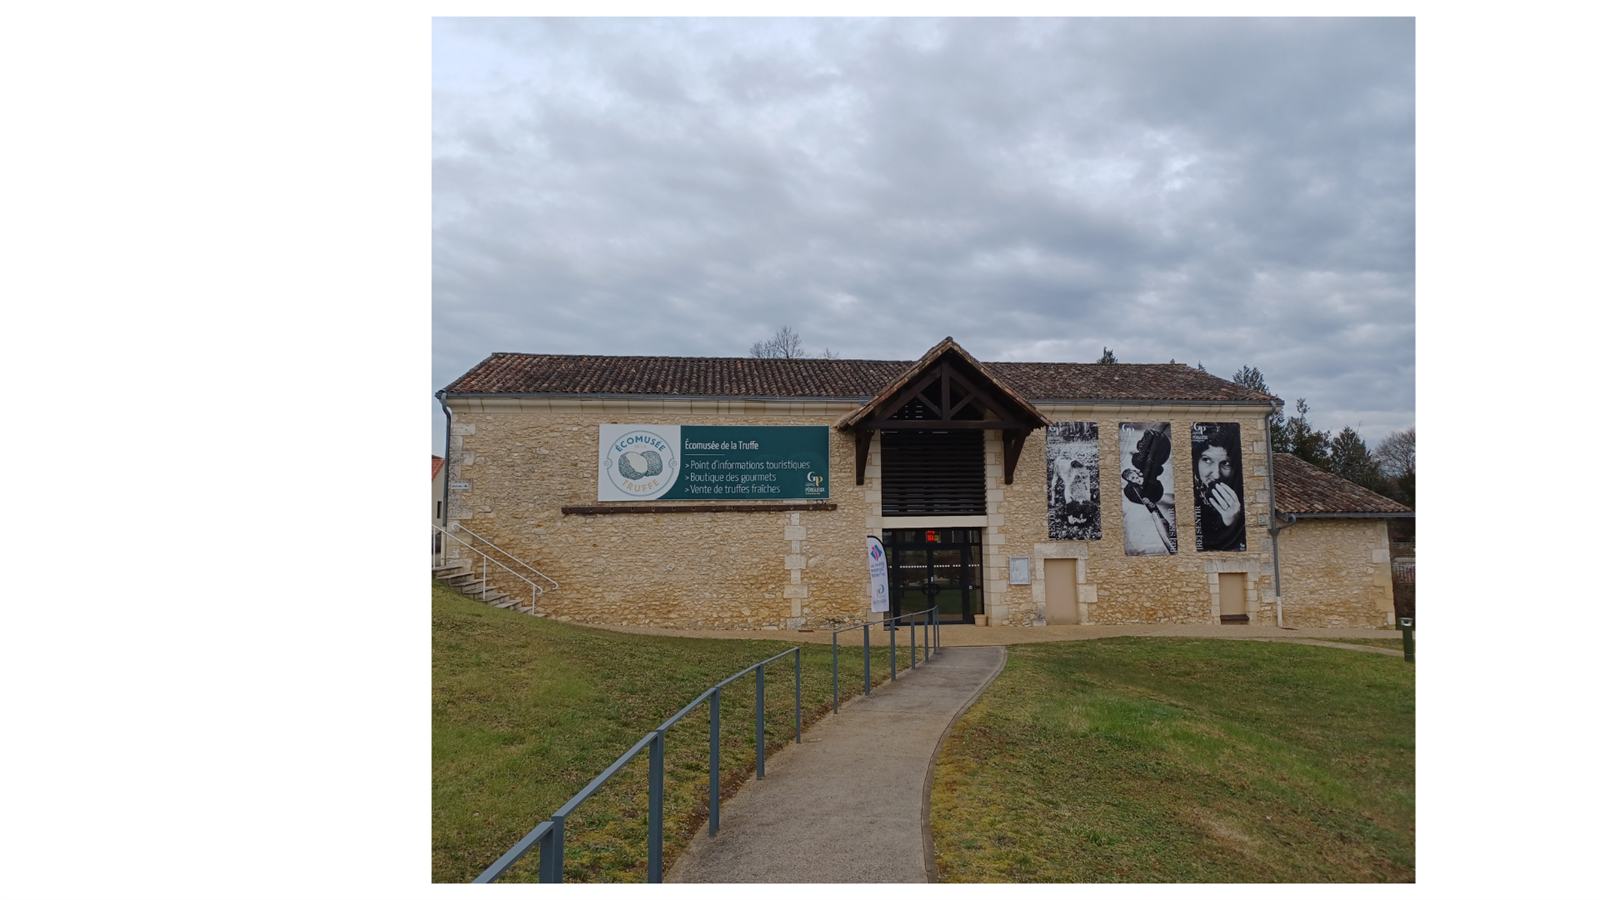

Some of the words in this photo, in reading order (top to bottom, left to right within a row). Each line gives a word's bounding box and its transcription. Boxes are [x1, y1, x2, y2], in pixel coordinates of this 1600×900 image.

[615, 435, 666, 453] ÉCOMUSÉE
[684, 438, 719, 450] Écomusée
[721, 440, 730, 450] de
[731, 440, 738, 450] la
[738, 440, 759, 450] Truffe
[690, 460, 710, 470] Point
[711, 460, 764, 470] d'informations
[766, 460, 811, 471] touristiques
[690, 472, 724, 483] Boutique
[726, 472, 739, 482] des
[740, 473, 777, 483] gourmets
[622, 479, 659, 493] TRUFFE
[690, 484, 712, 494] Vente
[713, 484, 723, 494] de
[724, 484, 750, 494] truffes
[751, 484, 781, 494] fraîches
